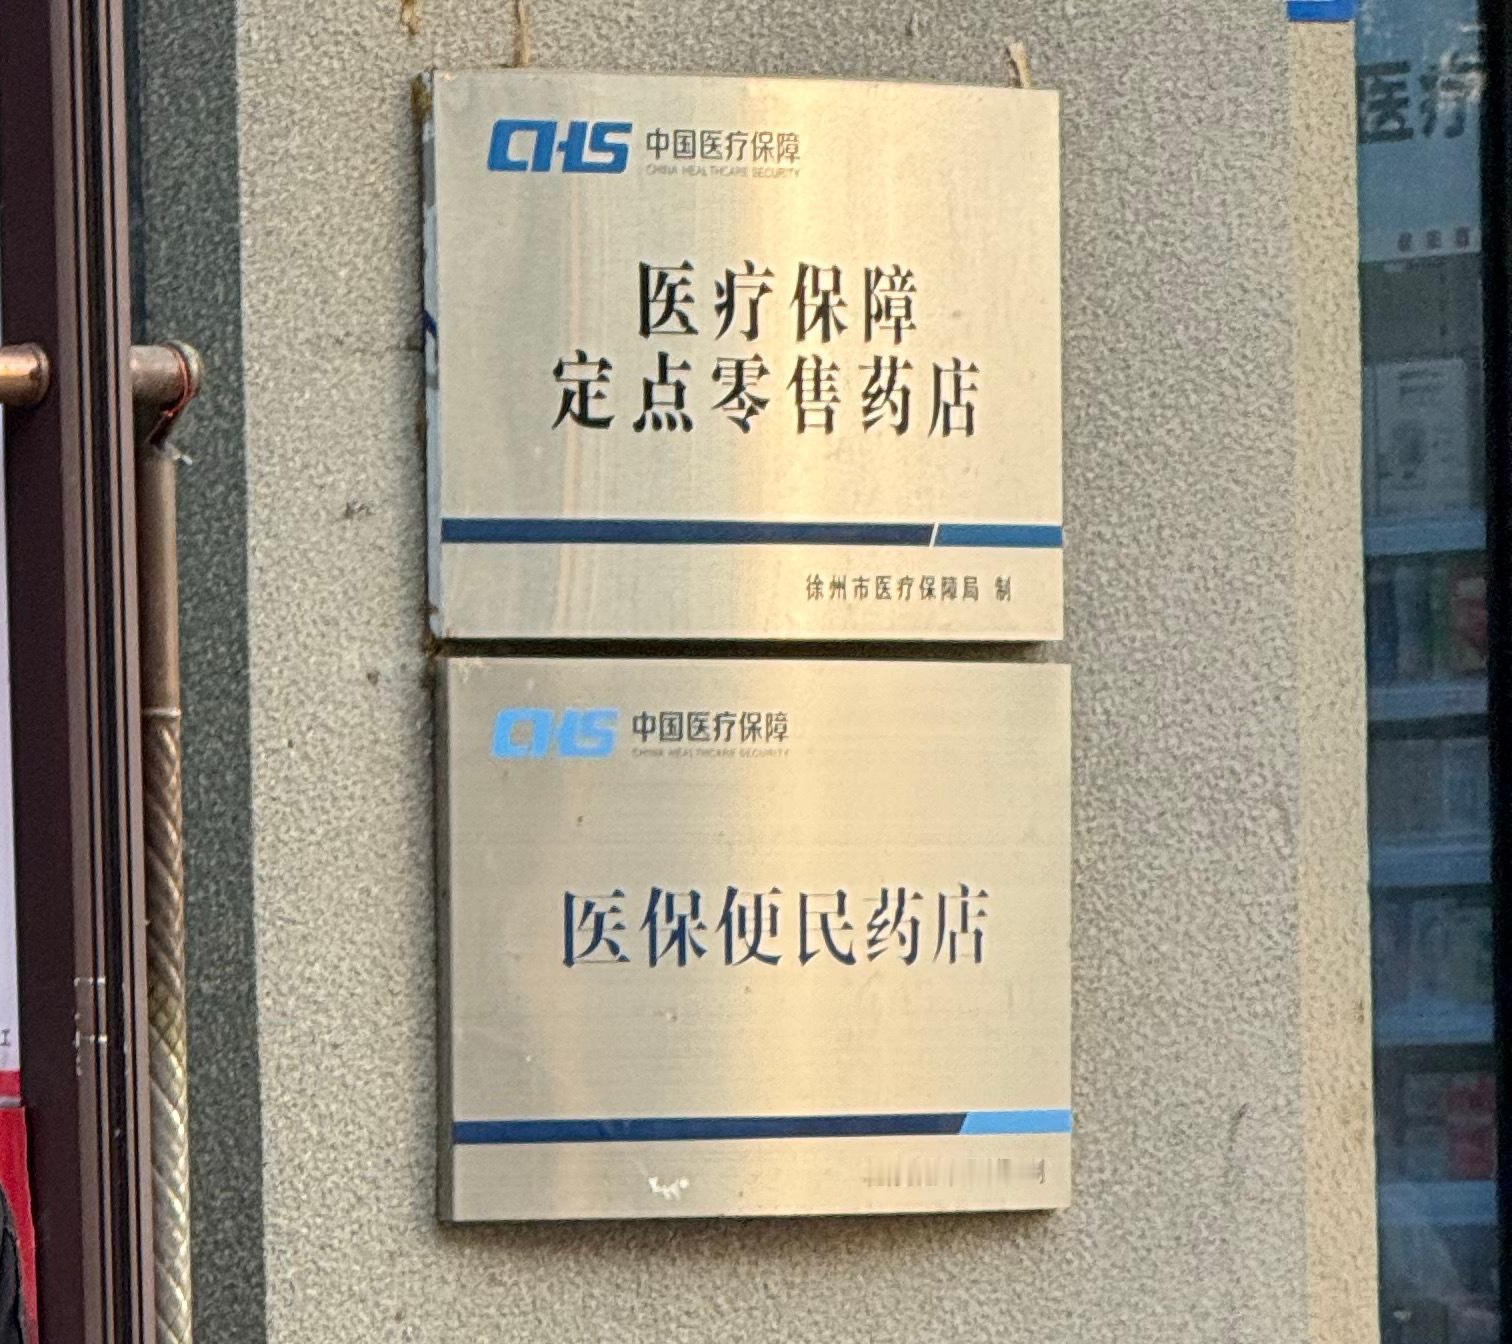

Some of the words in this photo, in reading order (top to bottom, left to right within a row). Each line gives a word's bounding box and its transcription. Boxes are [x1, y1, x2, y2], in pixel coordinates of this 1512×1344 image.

[487, 118, 633, 173] CHS
[645, 127, 801, 166] 中国医疗保障
[638, 259, 918, 346] 医疗保障
[551, 349, 981, 438] 定点零售药店
[805, 573, 979, 602] 徐州市医疗保障局
[994, 575, 1013, 602] 制
[491, 707, 619, 760] CHS
[631, 710, 790, 746] 中国医疗保障
[561, 883, 990, 968] 医保便民药店
